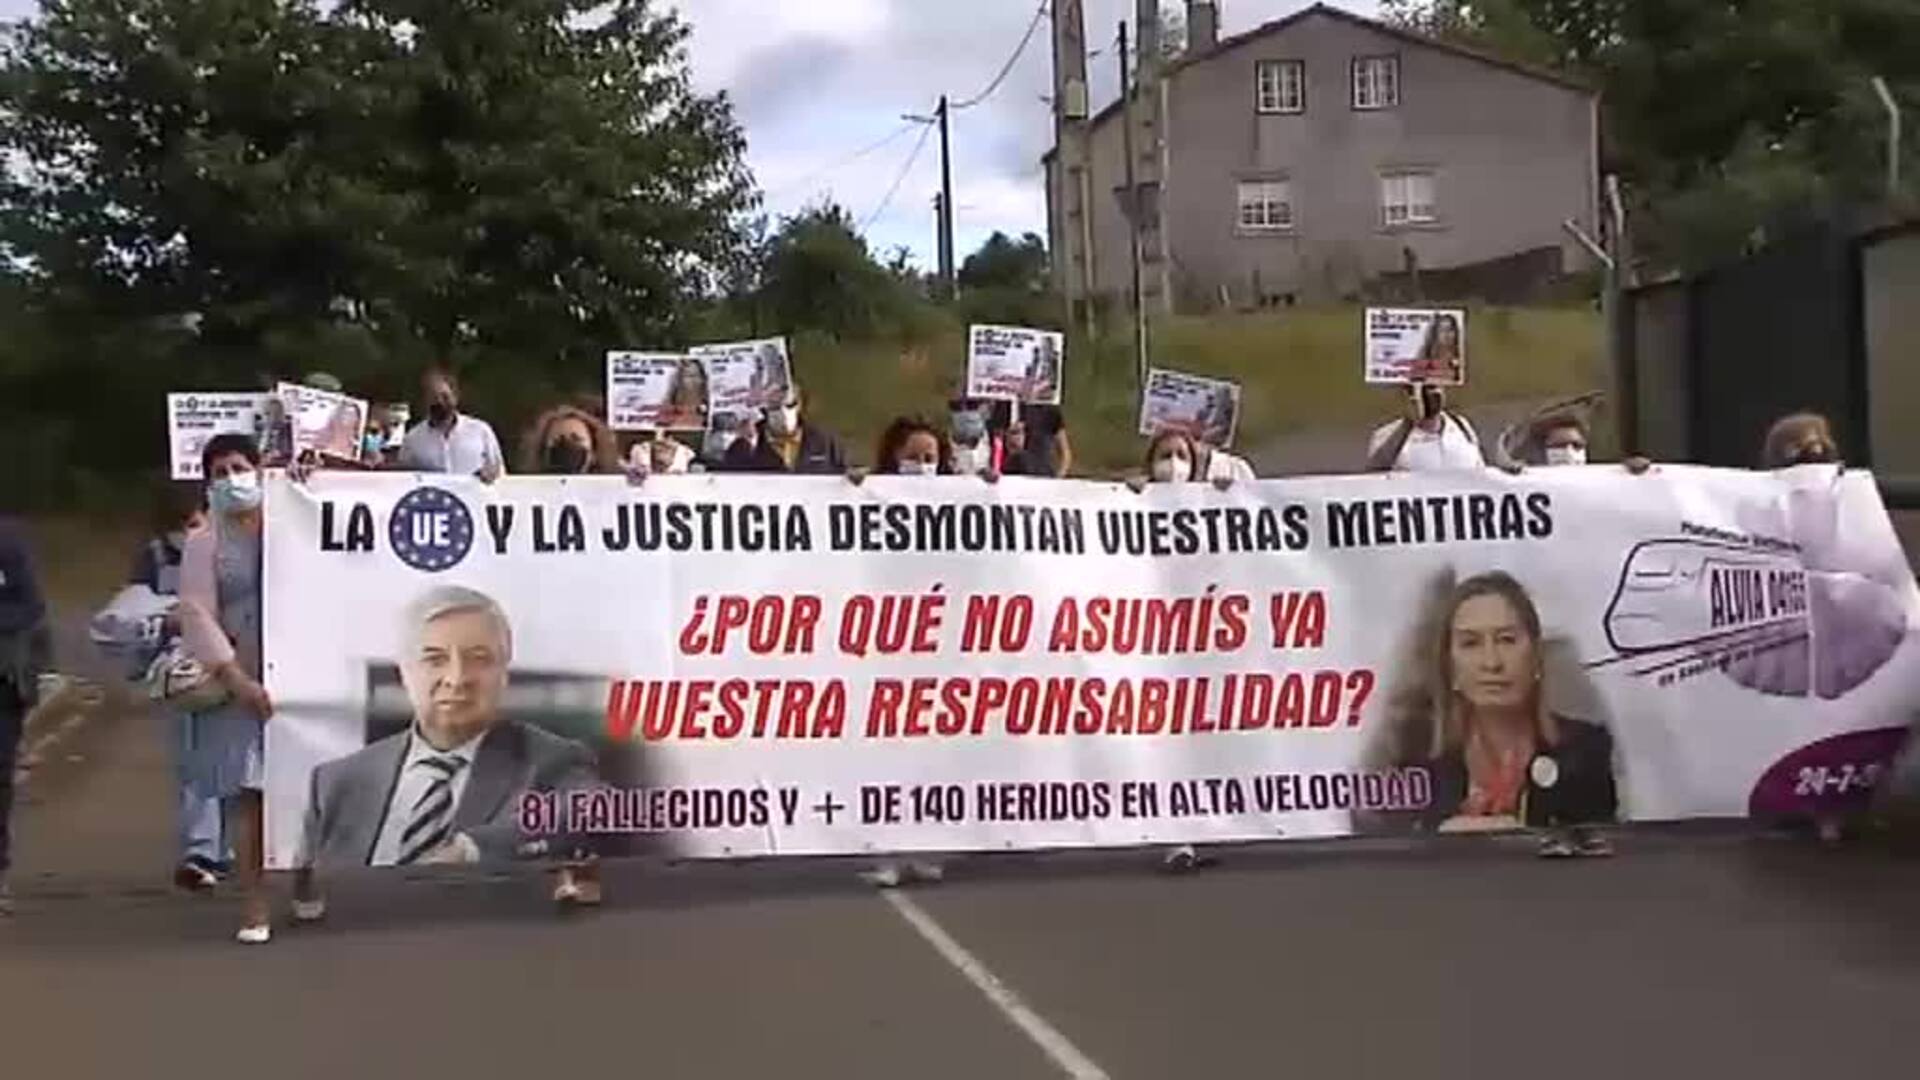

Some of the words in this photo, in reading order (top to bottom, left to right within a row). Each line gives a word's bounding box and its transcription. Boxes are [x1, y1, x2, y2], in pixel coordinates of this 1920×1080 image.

[320, 501, 375, 552] LA
[411, 511, 451, 547] UE
[486, 504, 514, 553] Y
[532, 503, 586, 552] LA
[602, 503, 813, 552] JUSTICIA
[829, 504, 1085, 555] DESMONTAN
[1099, 502, 1309, 555] VUESTRAS
[1327, 493, 1554, 548] MENTIRAS
[679, 595, 821, 655] ¿POR
[838, 583, 946, 657] QUÉ
[960, 595, 1033, 653] NO
[1048, 584, 1250, 654] ASUMÍS
[1270, 591, 1326, 649] YA
[1711, 569, 1765, 628] ALVIA
[607, 678, 848, 741] VUESTRA
[866, 669, 1375, 739] RESPONSABILIDAD?
[521, 792, 557, 831] 81
[570, 788, 769, 831] FALLECIDOS
[778, 788, 798, 827] Y
[861, 786, 900, 825] DE
[911, 785, 965, 823] 140
[977, 782, 1110, 822] HERIDOS
[1122, 782, 1157, 818] EN
[1170, 778, 1246, 816] ALTA
[1257, 770, 1430, 812] VELOCIDAD
